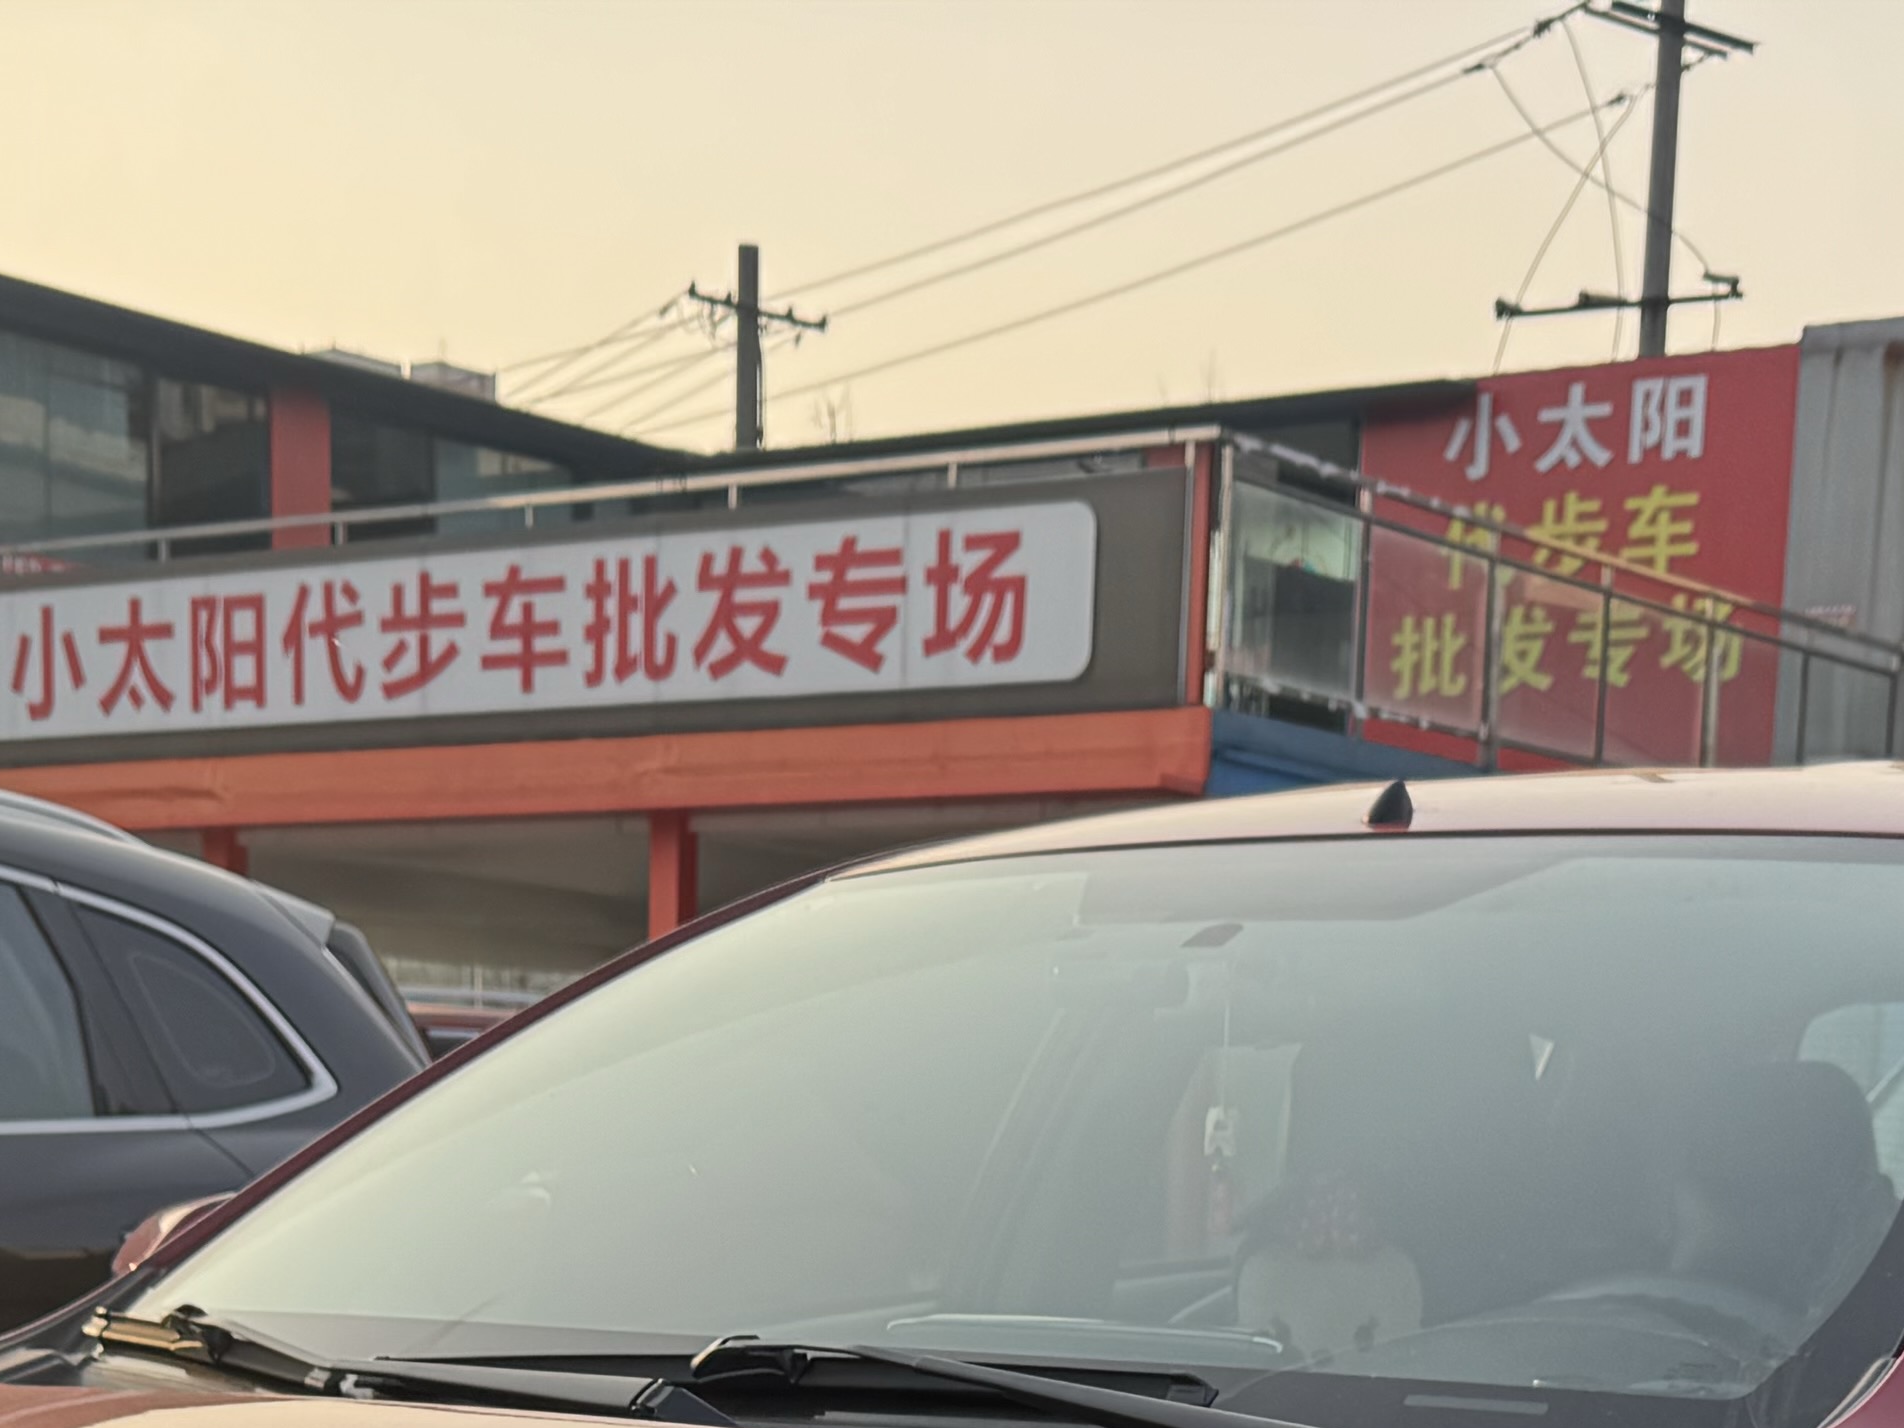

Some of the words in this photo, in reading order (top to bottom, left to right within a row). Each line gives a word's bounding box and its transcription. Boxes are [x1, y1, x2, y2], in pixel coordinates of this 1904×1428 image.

[1442, 373, 1709, 482] 小太阳
[10, 527, 1029, 722] 小太阳代步车批发专场
[1390, 592, 1746, 700] 批发专场
